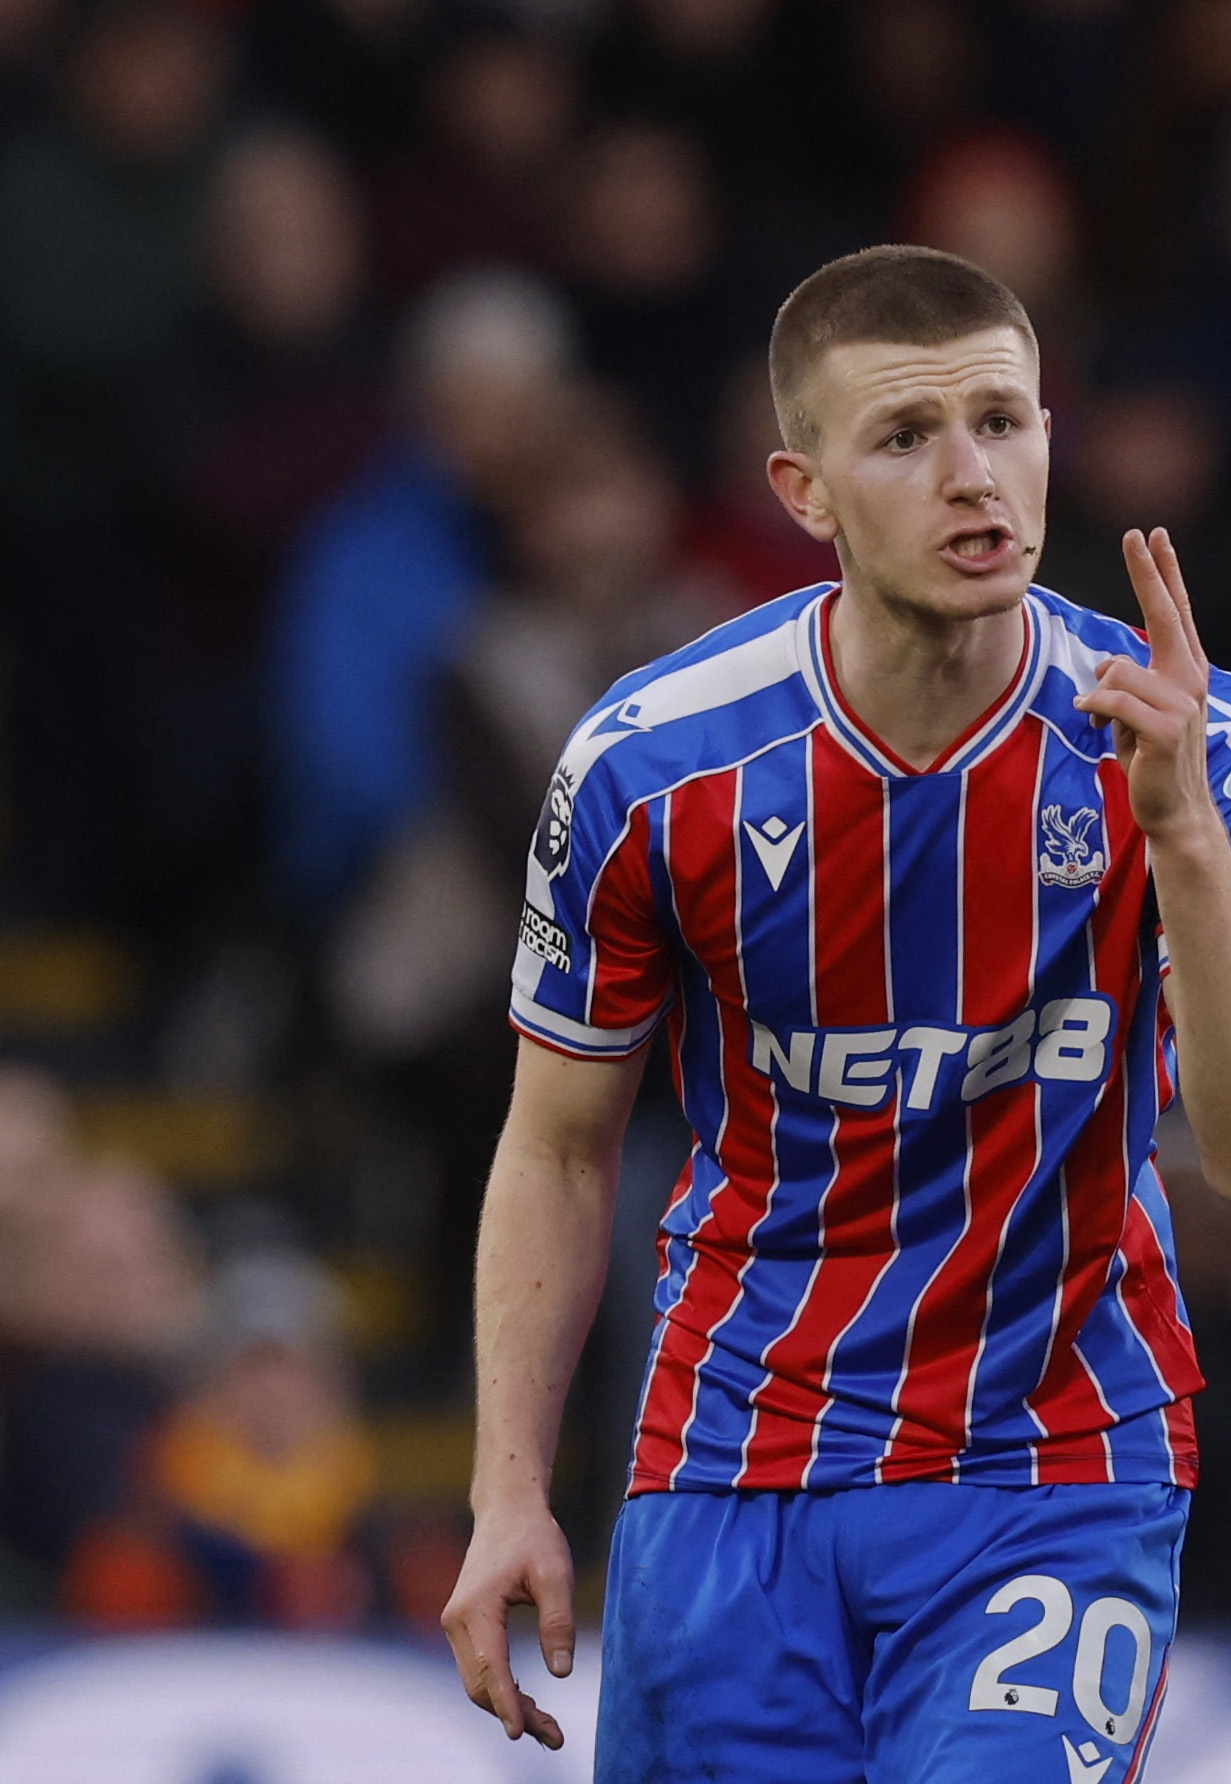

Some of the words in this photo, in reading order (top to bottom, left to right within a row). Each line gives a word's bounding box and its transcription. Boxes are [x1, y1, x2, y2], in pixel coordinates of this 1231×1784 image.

[521, 925, 571, 974] racism
[526, 907, 567, 951] room
[751, 998, 1111, 1110] NET88
[968, 1574, 1151, 1745] 20
